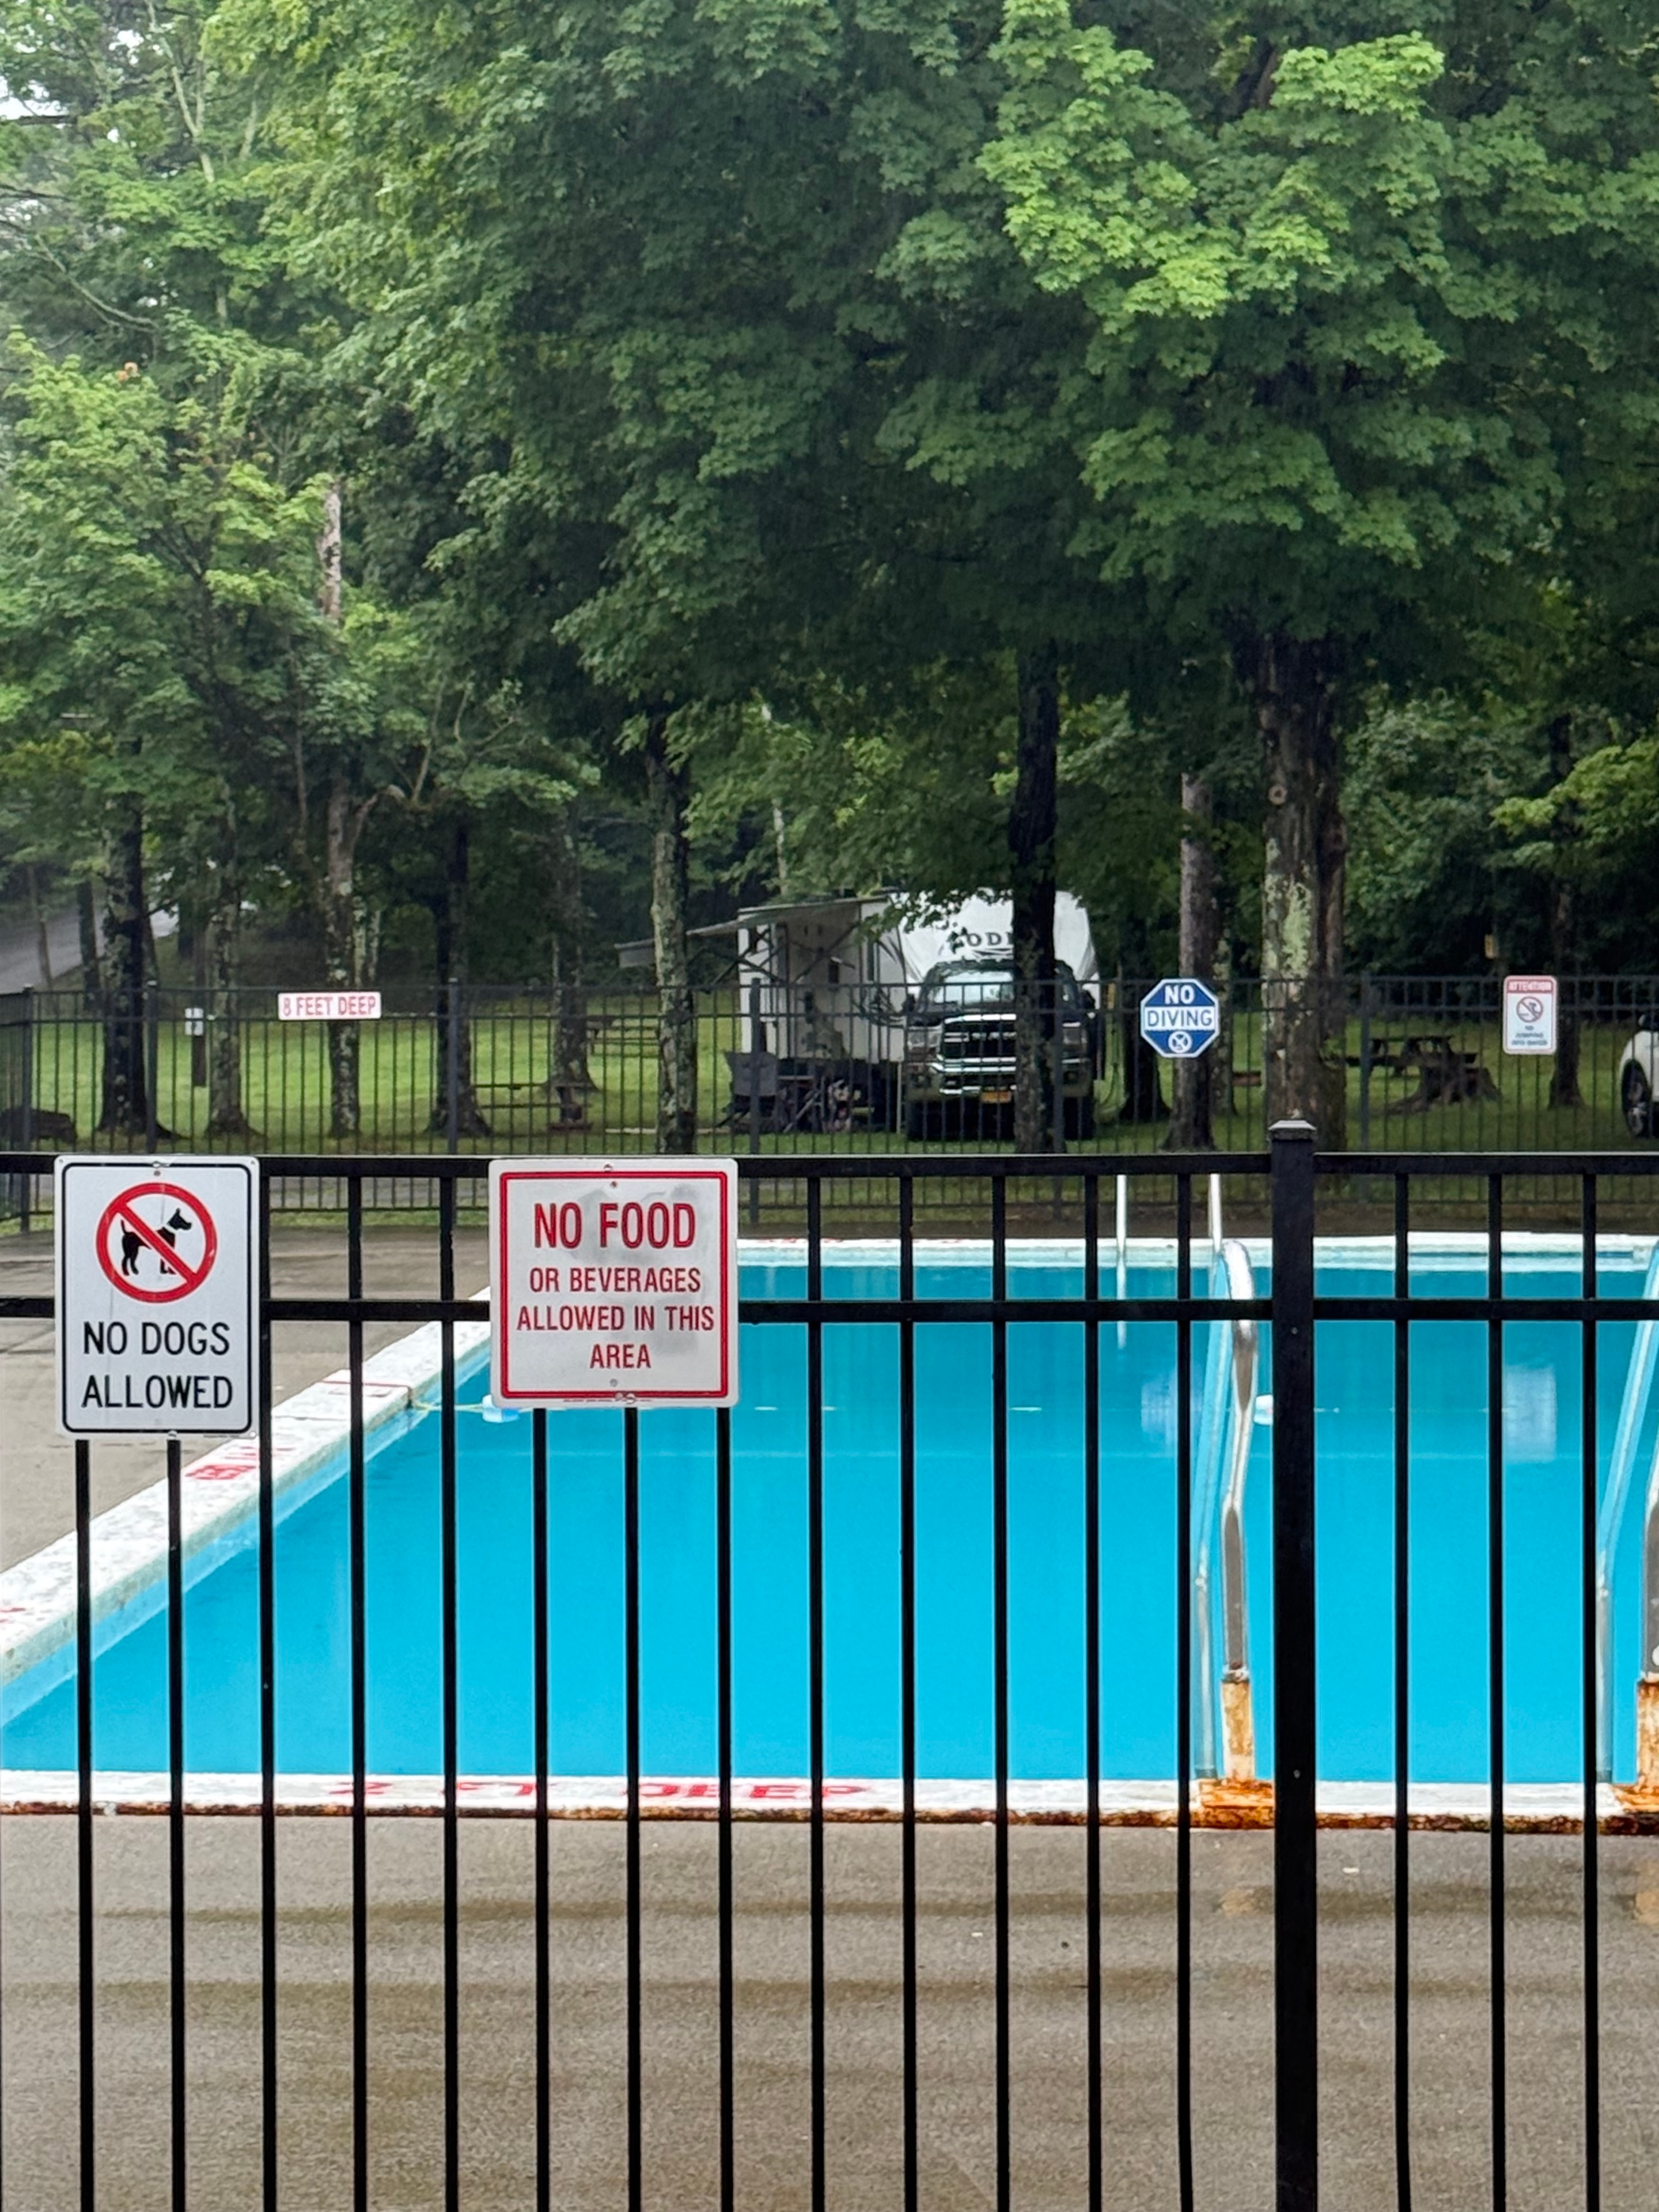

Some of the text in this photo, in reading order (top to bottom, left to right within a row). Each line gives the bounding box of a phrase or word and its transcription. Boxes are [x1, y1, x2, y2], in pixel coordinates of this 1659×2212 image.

[283, 995, 376, 1016] 8 FEET DEEP
[1164, 984, 1195, 1005] NO
[1147, 1009, 1212, 1027] DIVING
[534, 1202, 695, 1248] NO FOOD
[530, 1267, 701, 1293] OR BEVERAGES
[516, 1305, 714, 1331] ALLOWED IN THIS
[83, 1321, 230, 1355] NO DOGS
[589, 1344, 652, 1369] AREA
[81, 1374, 233, 1408] ALLOWED
[623, 1783, 869, 1800] DEEP
